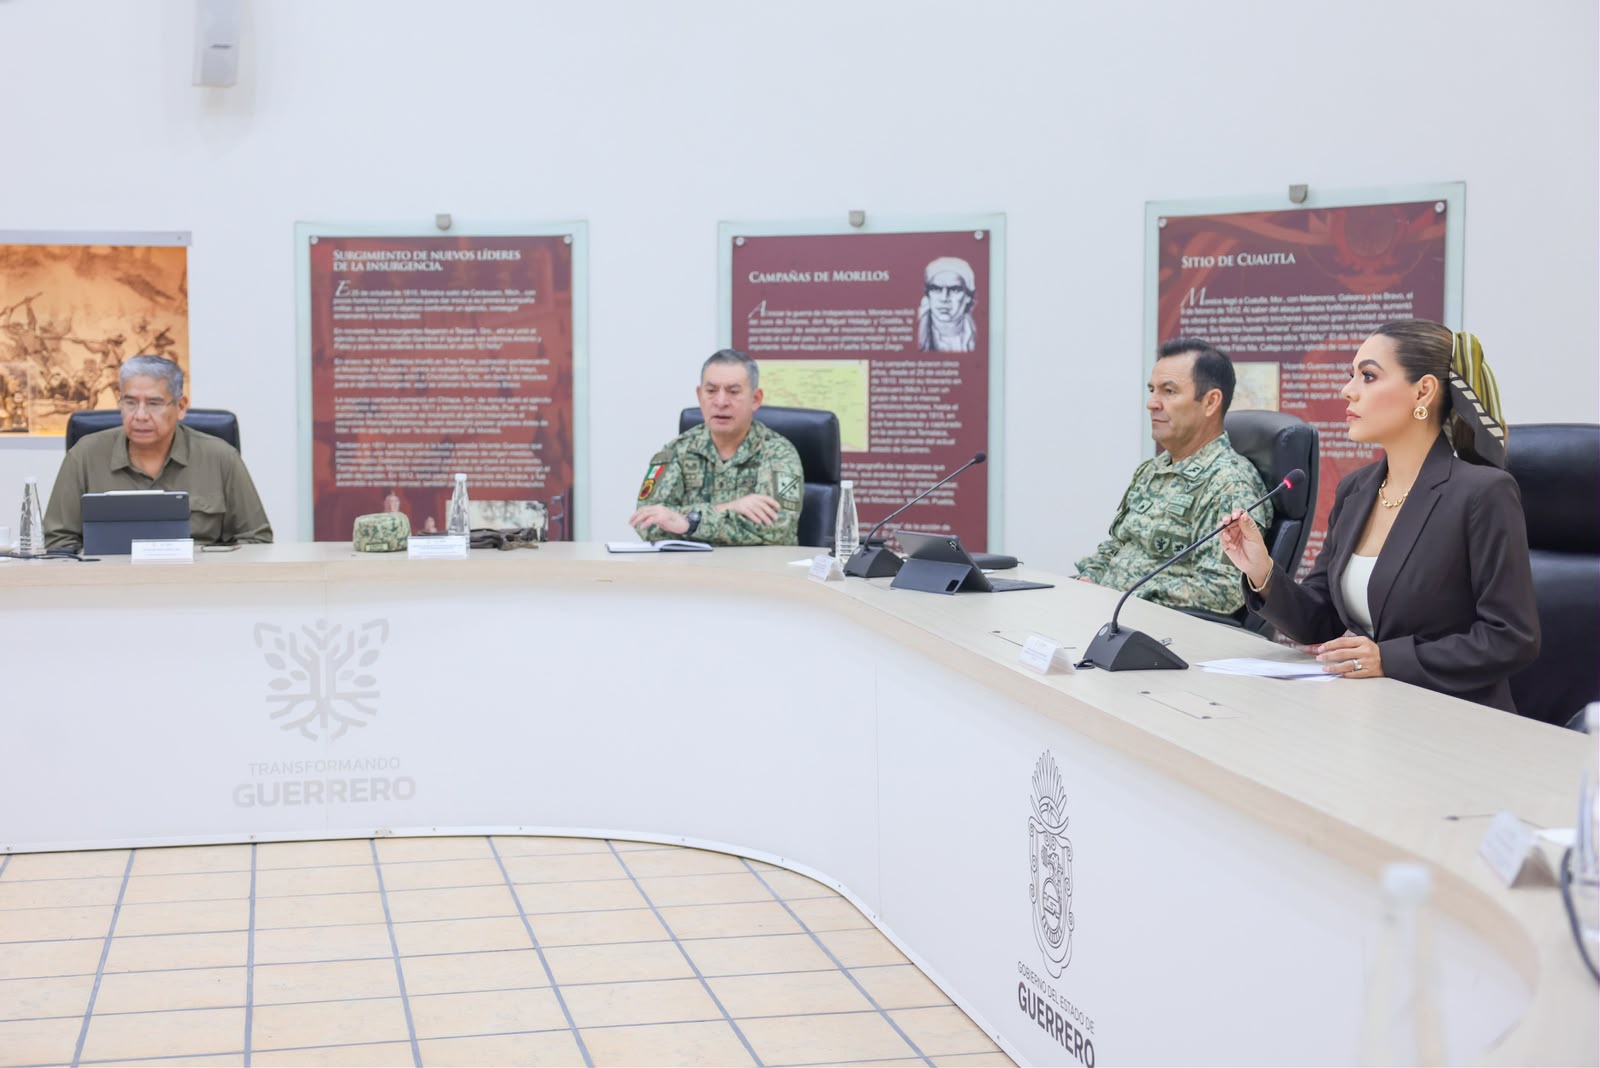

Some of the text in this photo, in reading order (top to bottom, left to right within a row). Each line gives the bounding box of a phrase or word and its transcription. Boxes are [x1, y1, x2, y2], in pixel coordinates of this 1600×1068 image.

[333, 248, 520, 260] SURGIMIENTO DE NUEVOS LÍDERES
[1182, 253, 1296, 268] SITIO DE CUAUTLA
[334, 262, 347, 271] DE
[351, 262, 364, 271] LA
[749, 270, 889, 283] CAMPAÑAS DE MORELOS
[248, 757, 400, 776] TRANSFORMANDO
[232, 776, 416, 808] GUERRERO
[1018, 961, 1094, 1034] GOBIERNO DEL ESTADO DE
[1018, 981, 1095, 1068] GUERRERO
